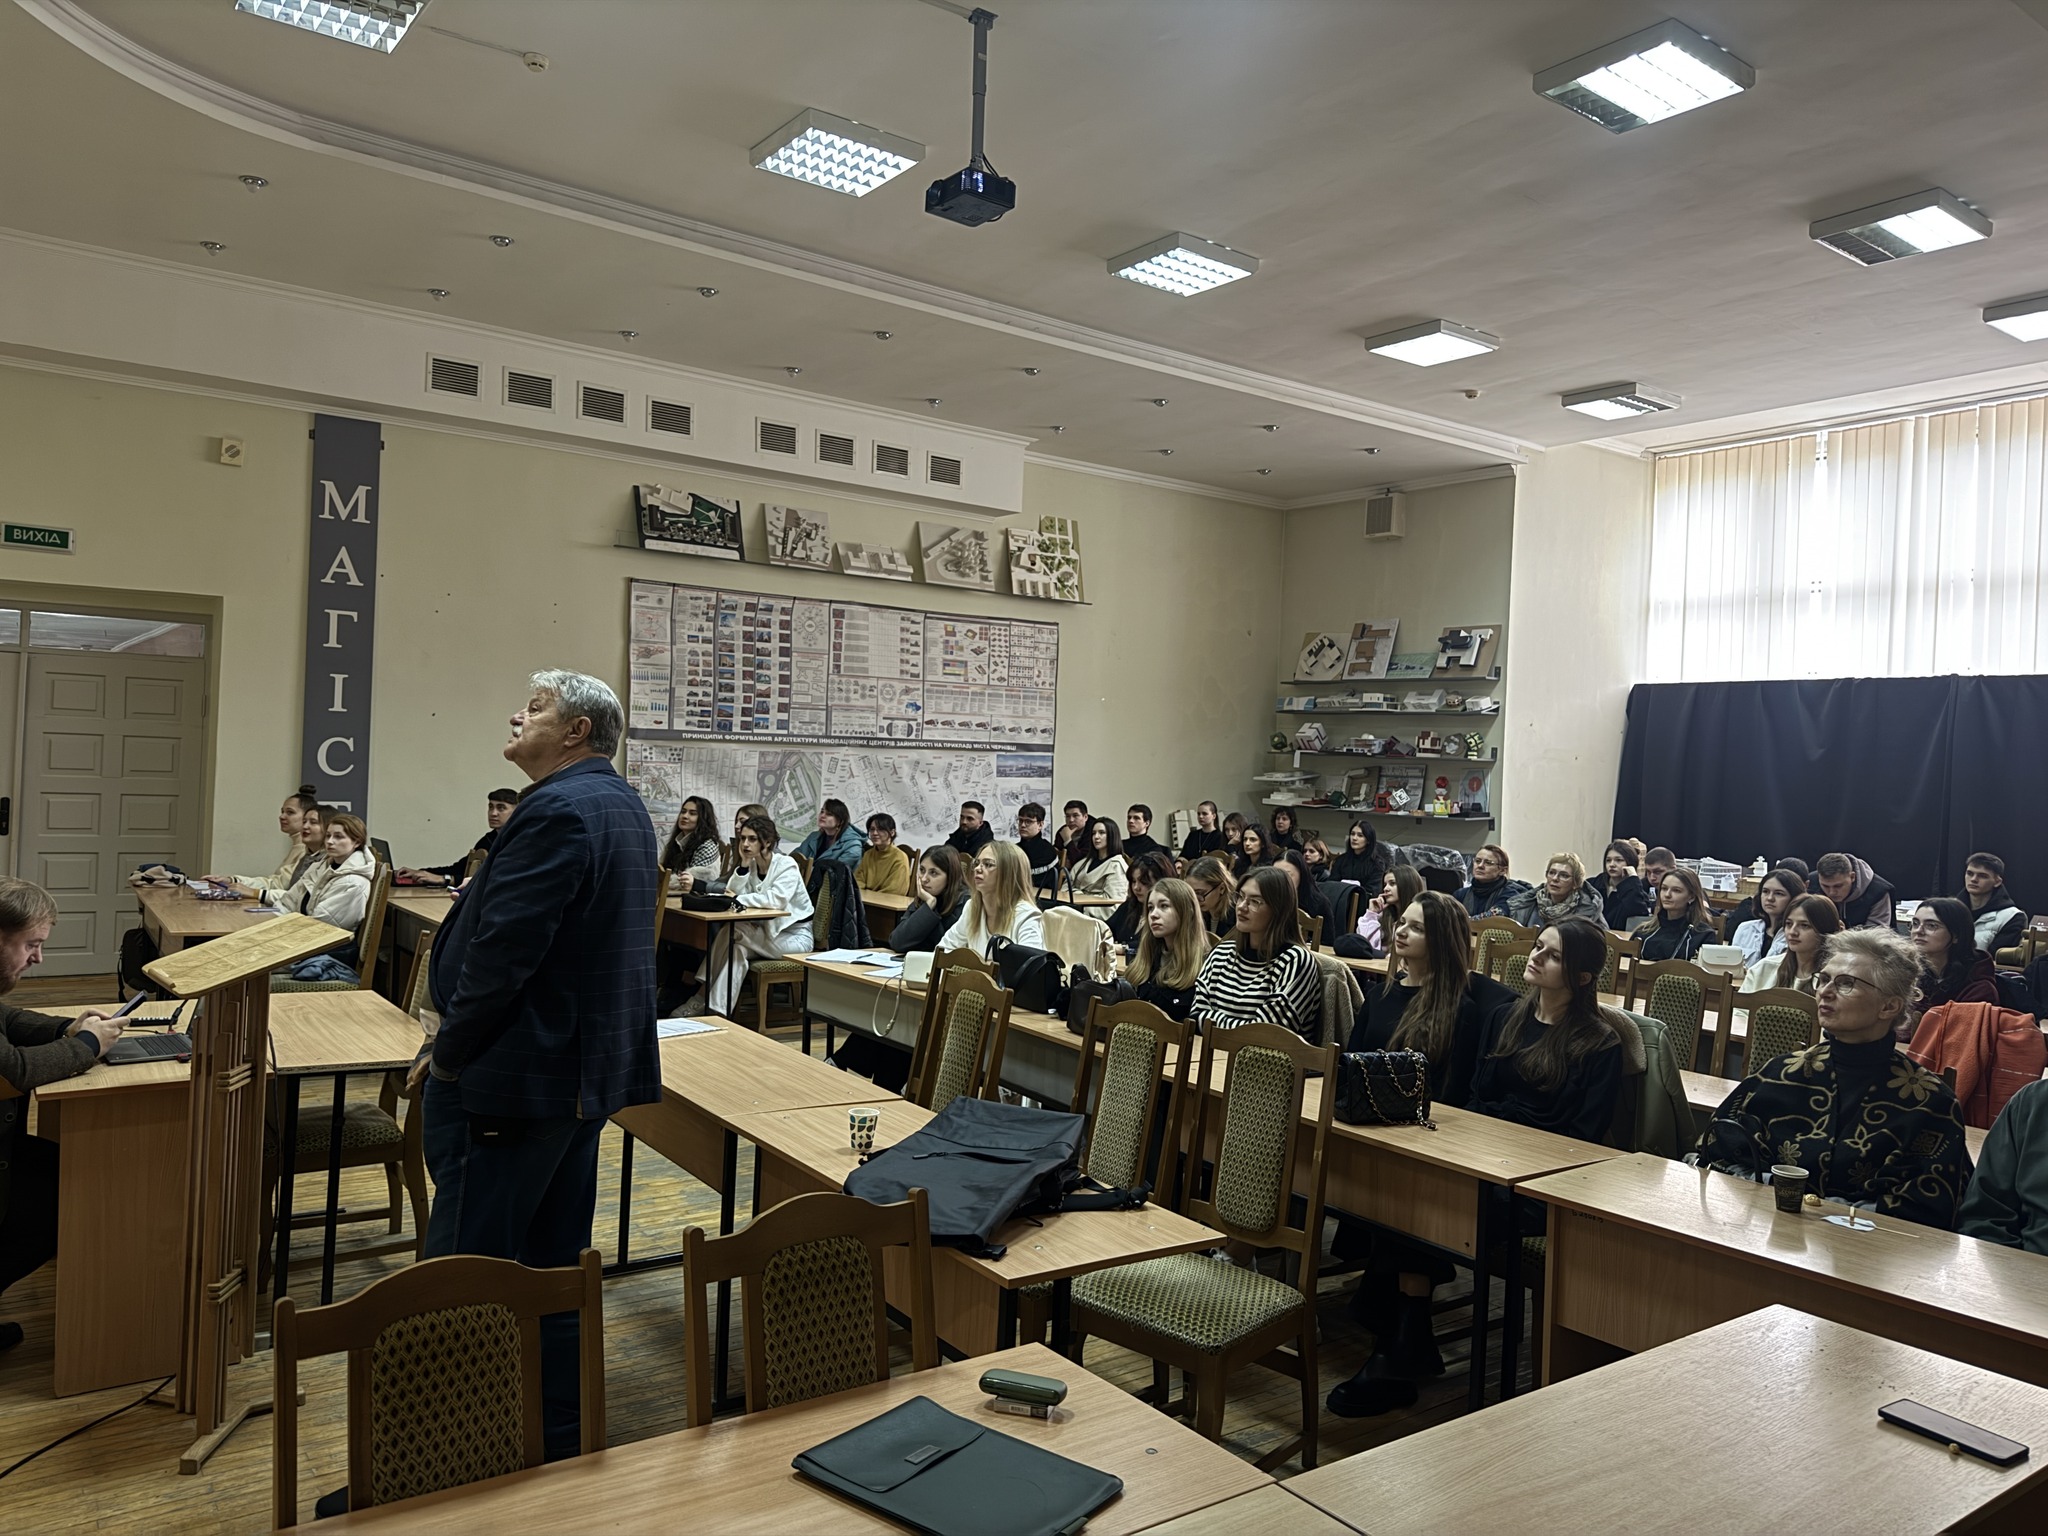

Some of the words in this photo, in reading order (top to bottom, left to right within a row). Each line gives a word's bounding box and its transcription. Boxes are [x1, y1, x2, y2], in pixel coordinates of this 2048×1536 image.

[13, 528, 61, 544] ВИХІД
[317, 480, 372, 812] МАГІС
[682, 732, 723, 740] ПРИНЦИПИ
[724, 734, 773, 742] ФОРМУВАННЯ
[774, 736, 818, 744] АРХІТЕКТУРИ
[819, 738, 868, 746] ІННОВАЦІЙНИХ
[868, 739, 895, 747] ЦЕНТРІВ
[896, 740, 933, 748] ЗАЙНЯТОСТІ
